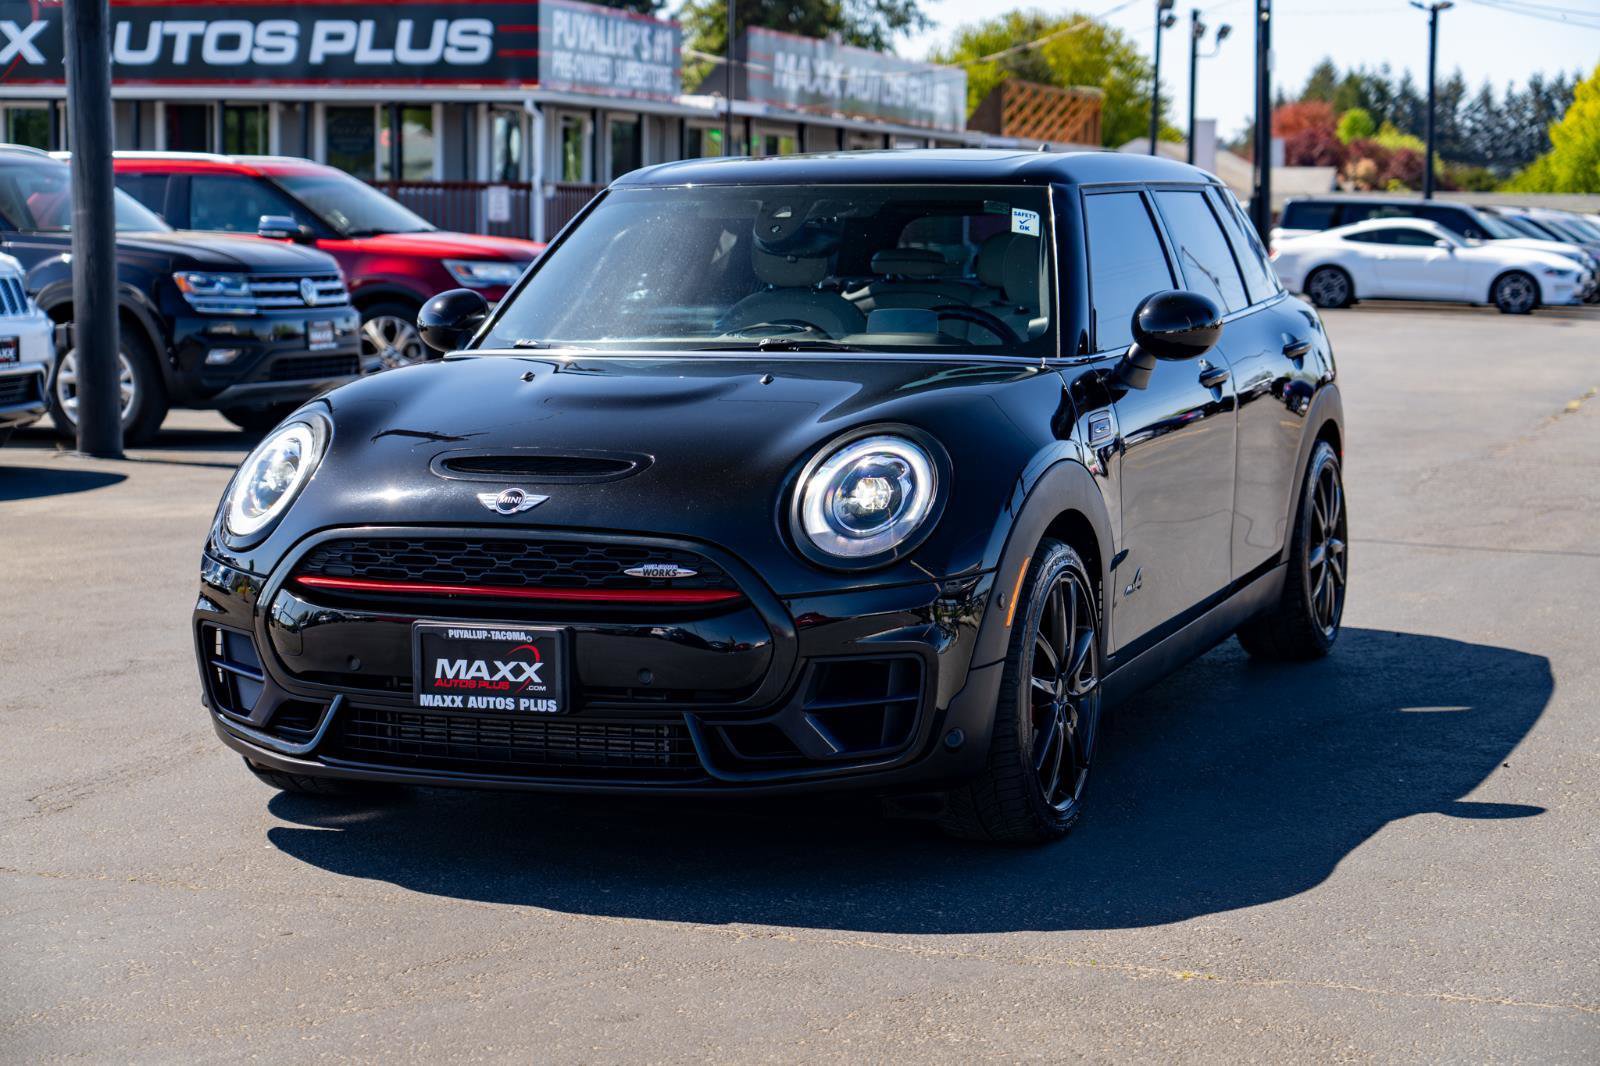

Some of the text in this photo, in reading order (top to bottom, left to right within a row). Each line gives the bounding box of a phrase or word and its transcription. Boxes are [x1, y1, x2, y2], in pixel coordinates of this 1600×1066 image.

[63, 20, 299, 64] UTOS
[309, 19, 493, 64] PLUS
[773, 51, 844, 98] MAXX
[1013, 211, 1036, 219] SAFETY
[643, 569, 678, 577] WORKS
[434, 658, 544, 683] MAXX
[434, 678, 510, 690] AUTOS PLUS
[420, 694, 558, 712] MAXX AUTOS PLUS
